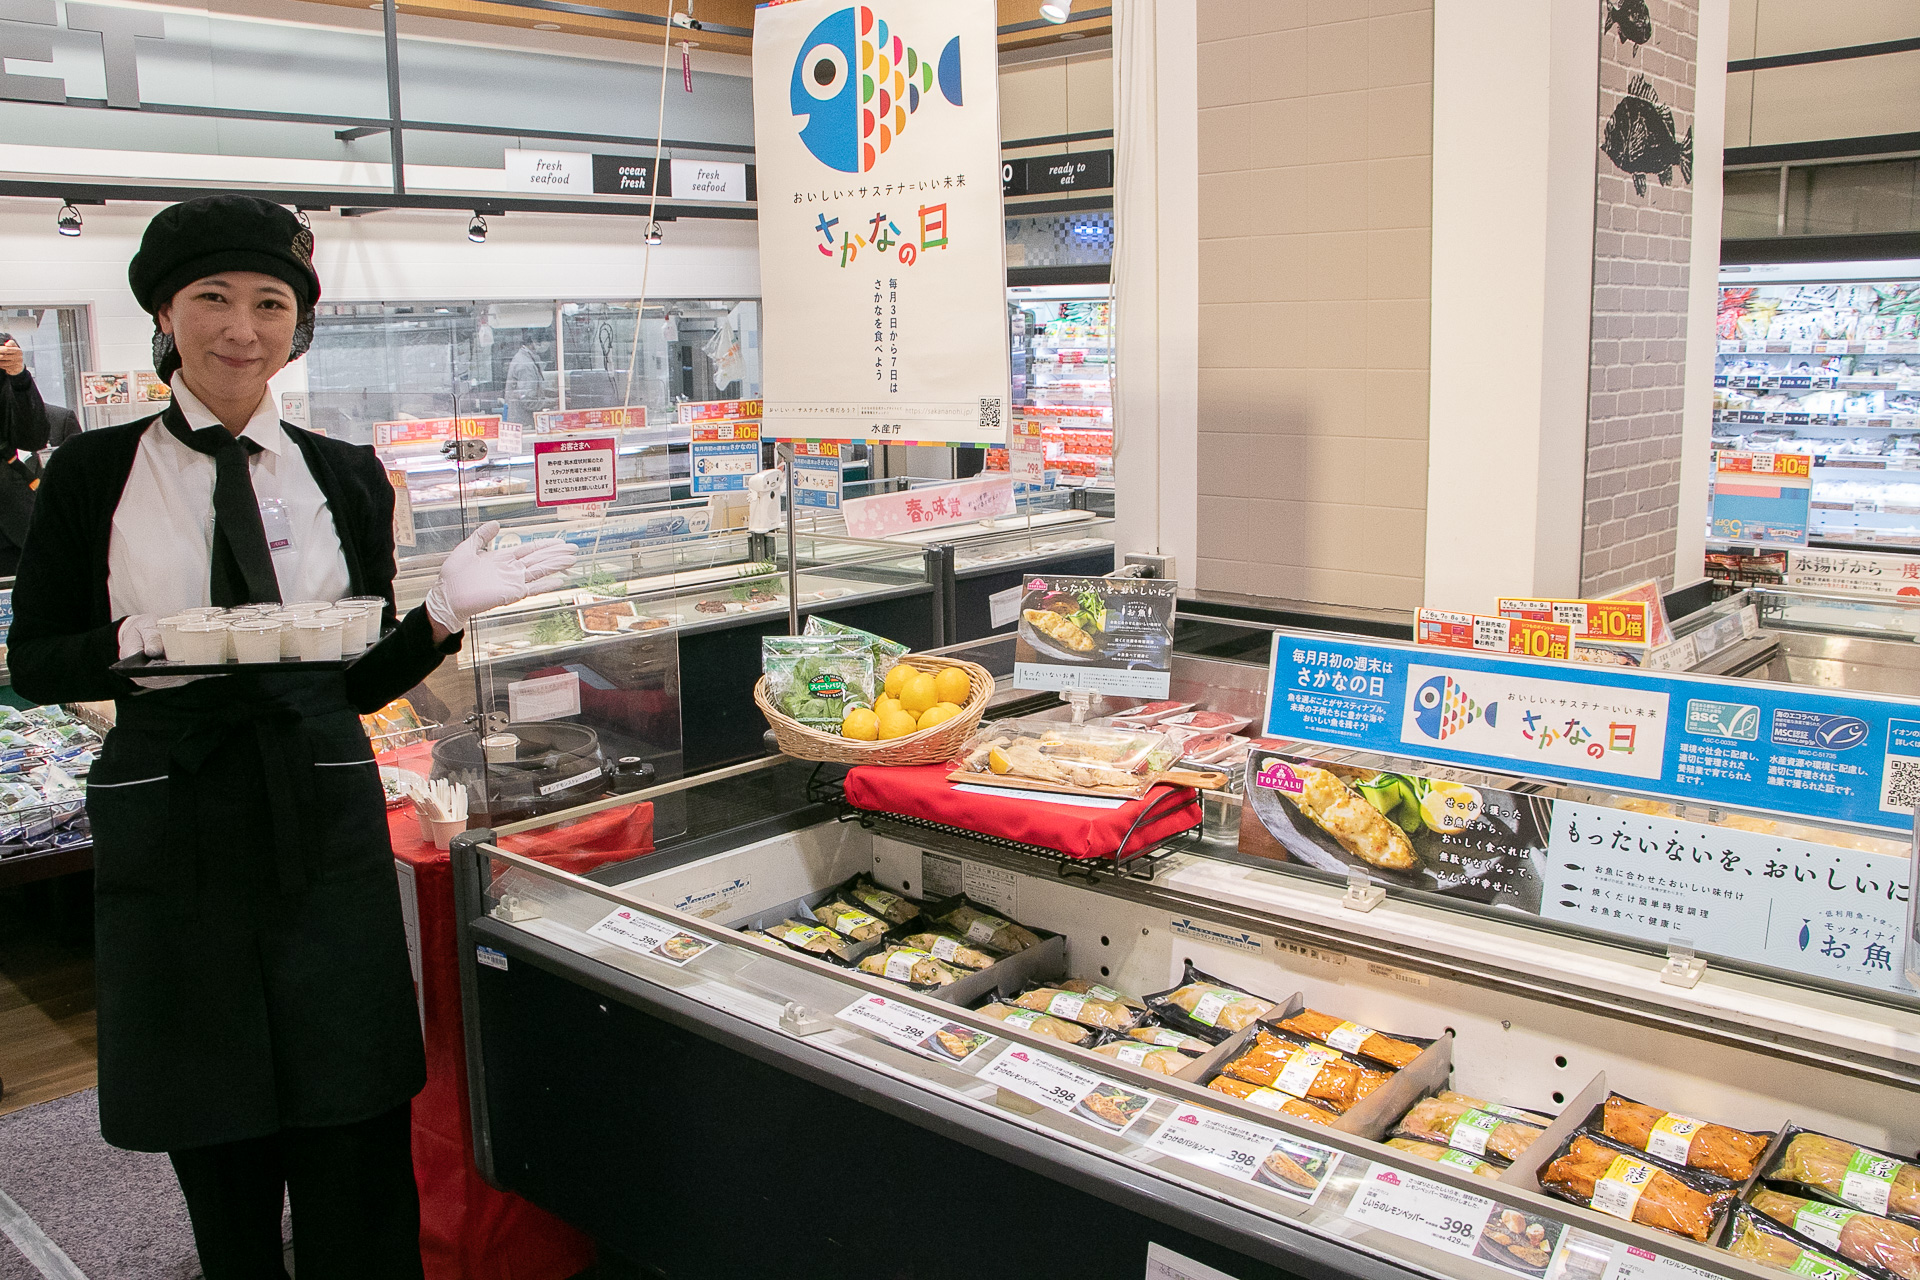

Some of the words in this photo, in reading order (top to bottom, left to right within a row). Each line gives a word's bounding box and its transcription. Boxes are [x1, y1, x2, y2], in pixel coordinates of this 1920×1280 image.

[536, 158, 562, 171] fresh
[618, 166, 646, 177] ocean
[697, 168, 720, 180] fresh
[1049, 162, 1074, 176] ready
[1077, 163, 1086, 172] to
[530, 172, 570, 184] seafood
[620, 176, 646, 189] fresh
[692, 181, 726, 192] seafood
[1060, 175, 1075, 184] eat
[794, 174, 966, 204] おいしい×サステナ=いい未来
[815, 203, 948, 268] さかなの日
[874, 279, 883, 380] さかなを食べよう
[889, 278, 898, 393] 毎月3日から7日は
[871, 424, 901, 434] 水産庁
[560, 442, 590, 451] お客さまへ
[1775, 458, 1807, 474] +10倍
[905, 496, 962, 523] 春の味覚
[1795, 556, 1920, 579] 水揚げから一度
[1589, 611, 1642, 636] +10倍
[1511, 628, 1566, 659] +10倍
[1292, 648, 1393, 673] 毎月月初の週末は
[1298, 667, 1384, 697] さかなの日
[1287, 693, 1386, 714] 魚を選ぶことがサスティナブル。
[1290, 703, 1384, 723] 未来の子供たちに豊かな海や
[1508, 693, 1656, 718] おいしい×サステナ=いい未来
[1690, 711, 1719, 723] asc
[1776, 711, 1820, 721] 海のエコラベル
[1522, 710, 1637, 759] さかなの日
[1774, 728, 1809, 740] MSC認証
[1679, 753, 1745, 770] 適切に管理された
[1680, 743, 1759, 762] 環境や社会に配慮し、
[1678, 764, 1752, 781] 養殖業で育てられた
[1768, 766, 1836, 782] 適切に管理された
[1770, 755, 1868, 776] 水産資源や環境に配慮し、
[1260, 776, 1301, 789] TOPVALU
[1676, 774, 1704, 785] 証です。
[1767, 776, 1855, 796] 漁業で獲られた証です。
[1446, 798, 1521, 819] せっかく獲った
[1444, 816, 1502, 836] お魚だから、
[1442, 834, 1530, 859] おいしく食べれば
[1439, 851, 1532, 880] 無駄がなくなって、
[1437, 871, 1519, 896] みんなが幸せに。
[1595, 865, 1744, 901] お魚に合わせたおいしい味付け
[1592, 888, 1709, 918] 焼くだけ簡単時短調理
[1590, 905, 1681, 931] お魚食べて健康に
[640, 935, 658, 946] 398
[1824, 922, 1896, 944] モッタイナイ
[1820, 935, 1892, 971] お魚
[1837, 964, 1872, 975] シリーズ
[994, 1066, 1040, 1087] ほっけのレモンペッパー
[1162, 1133, 1215, 1154] ほっけのバジルソース
[1406, 1183, 1479, 1209] レモンペッパーで味付けしました。
[1362, 1197, 1425, 1221] しいらのレモンペッパー
[1440, 1217, 1475, 1240] 398円
[1618, 1267, 1630, 1276] 国産
